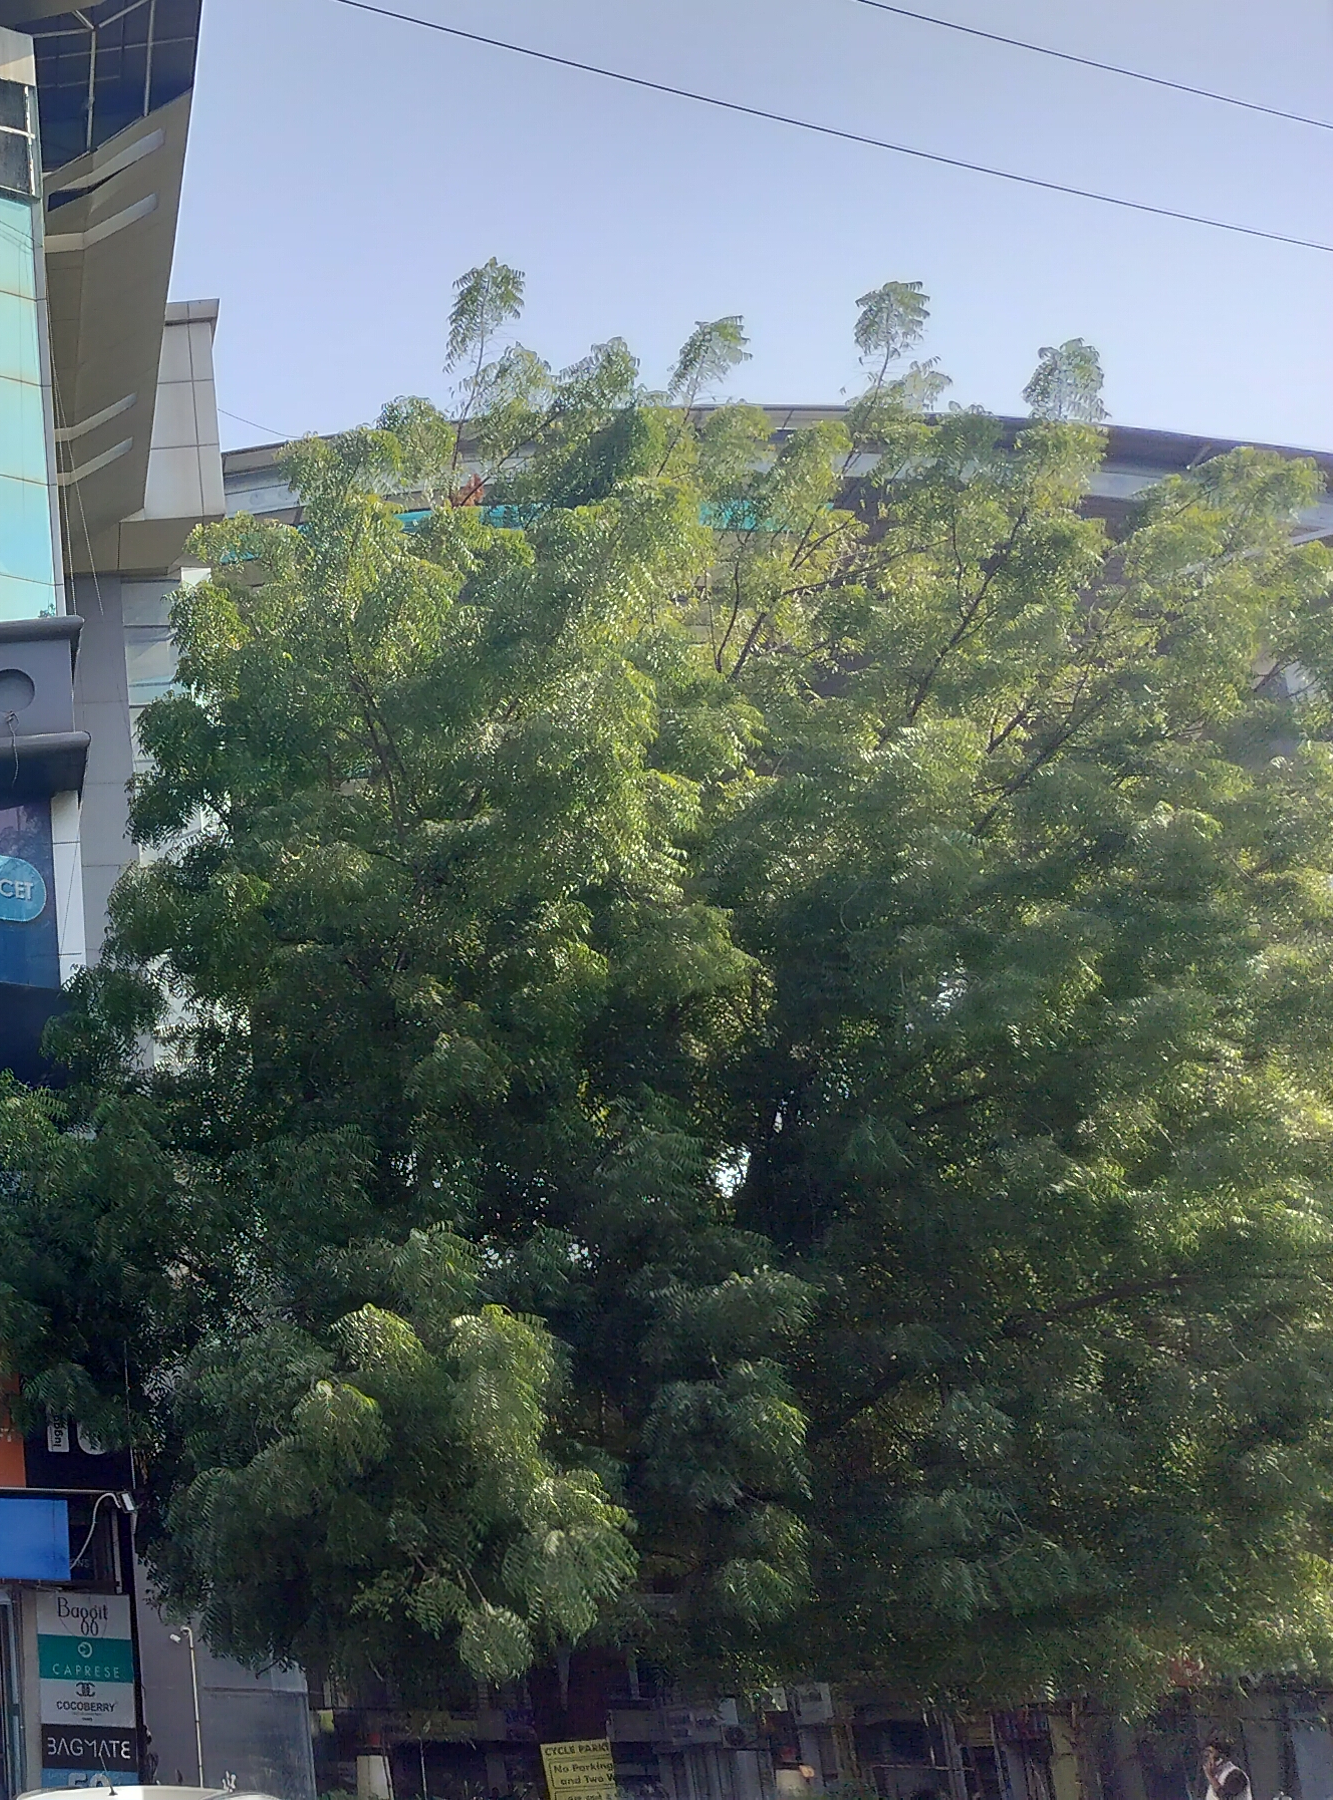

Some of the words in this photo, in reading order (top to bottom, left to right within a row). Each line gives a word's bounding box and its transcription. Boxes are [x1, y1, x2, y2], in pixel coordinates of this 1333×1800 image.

[52, 1663, 121, 1679] CAPRESE
[56, 1700, 116, 1714] COCOBERRY
[47, 1736, 132, 1760] BAGMATE
[544, 1744, 576, 1757] CYCLE
[553, 1763, 570, 1774] No
[560, 1776, 582, 1786] and
[584, 1774, 605, 1784] Two
